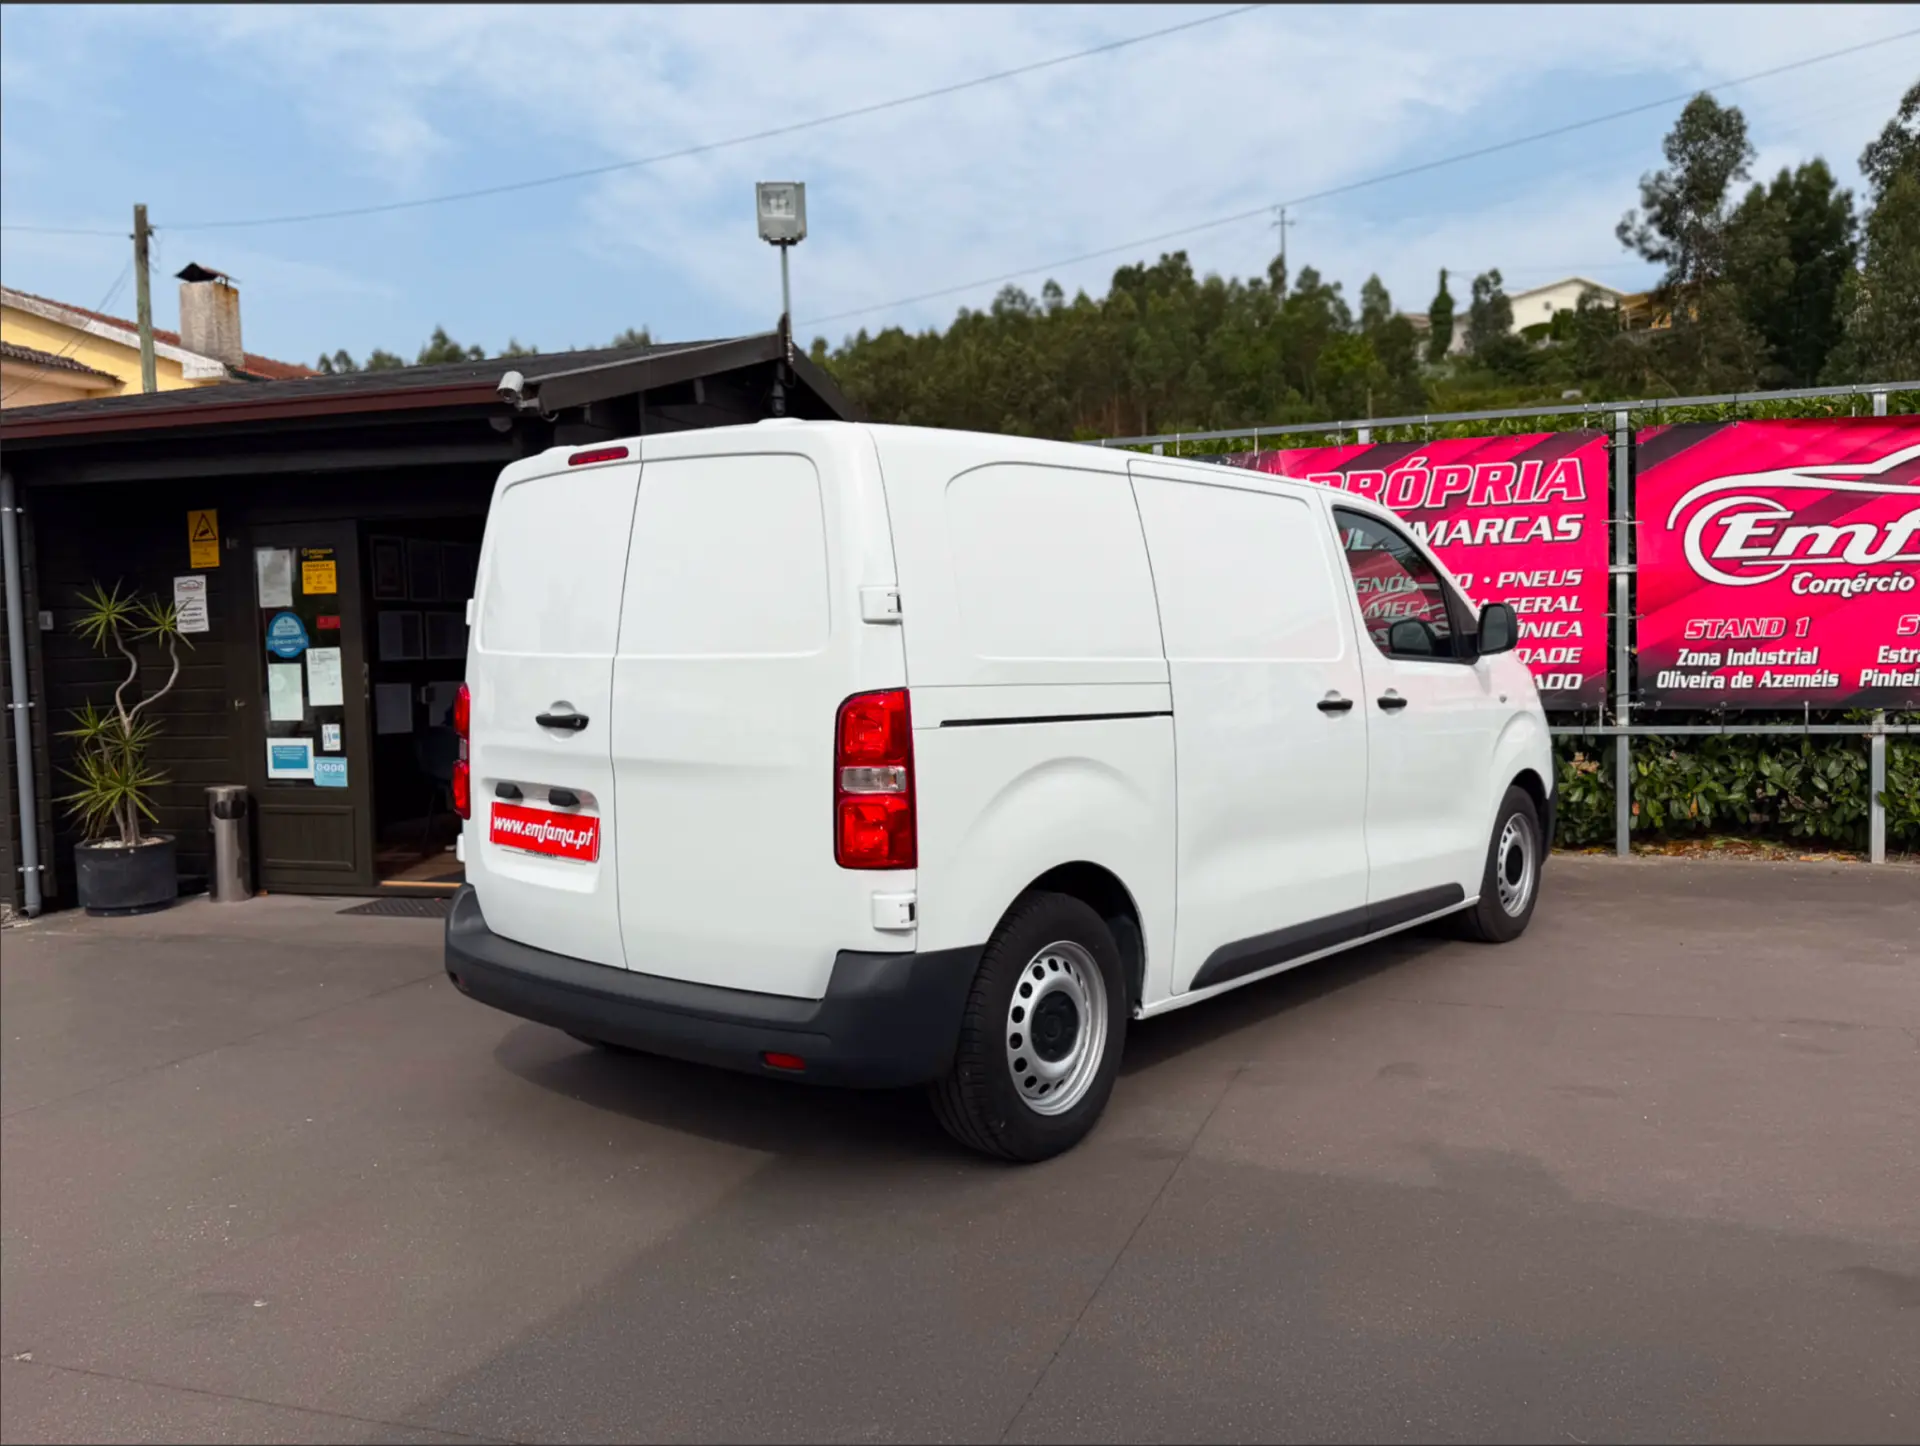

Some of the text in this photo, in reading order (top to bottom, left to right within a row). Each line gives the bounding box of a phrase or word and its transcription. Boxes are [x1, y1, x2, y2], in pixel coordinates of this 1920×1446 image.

[1496, 569, 1583, 588] PNEUS
[1791, 571, 1915, 598] Comércio
[1684, 617, 1811, 638] STAND 1
[1897, 614, 1920, 636] S
[1676, 646, 1819, 666] Zona Industrial
[1657, 669, 1839, 689] Oliveira de Azeméis
[493, 815, 594, 849] www.emfama.pt
